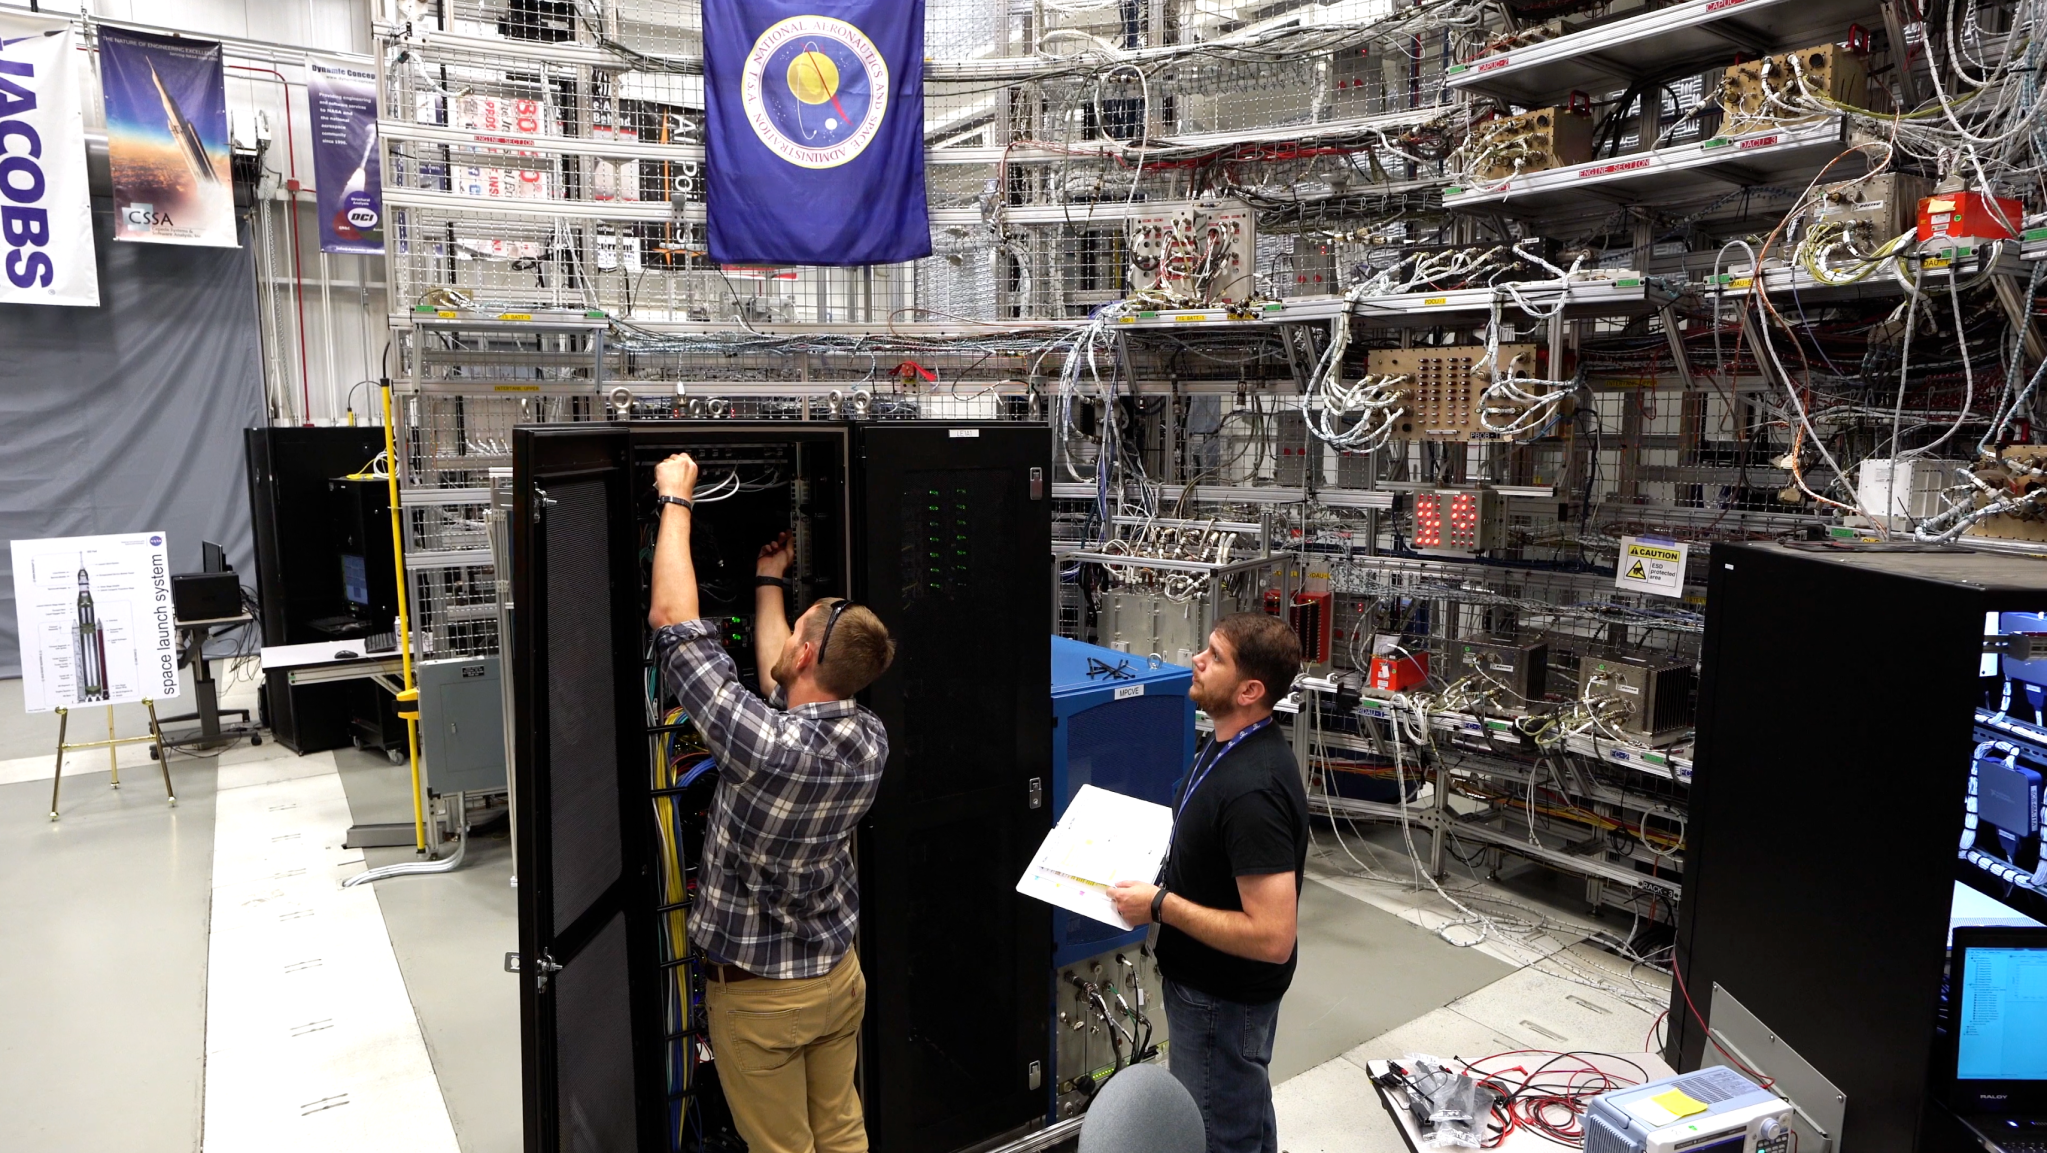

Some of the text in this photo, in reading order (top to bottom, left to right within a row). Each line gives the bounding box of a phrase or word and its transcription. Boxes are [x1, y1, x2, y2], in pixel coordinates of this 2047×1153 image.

[115, 38, 139, 46] NATURE
[148, 42, 185, 52] ENGINEERING
[186, 47, 218, 56] EXCELLENCE
[753, 22, 807, 65] NATIONAL
[813, 22, 883, 78] AERONAUTICS
[312, 65, 376, 79] Dynamic Concep
[319, 92, 342, 100] Providing
[875, 83, 884, 110] AND
[754, 113, 846, 162] ADMINISTRATION
[850, 115, 877, 150] SPACE
[1579, 159, 1650, 178] ENGINE SECTION
[128, 210, 174, 226] CSSA
[351, 213, 374, 221] DCI
[1640, 549, 1678, 560] CAUTION
[1650, 569, 1675, 577] protected
[151, 554, 177, 694] space launch system
[1643, 882, 1663, 894] RACK
